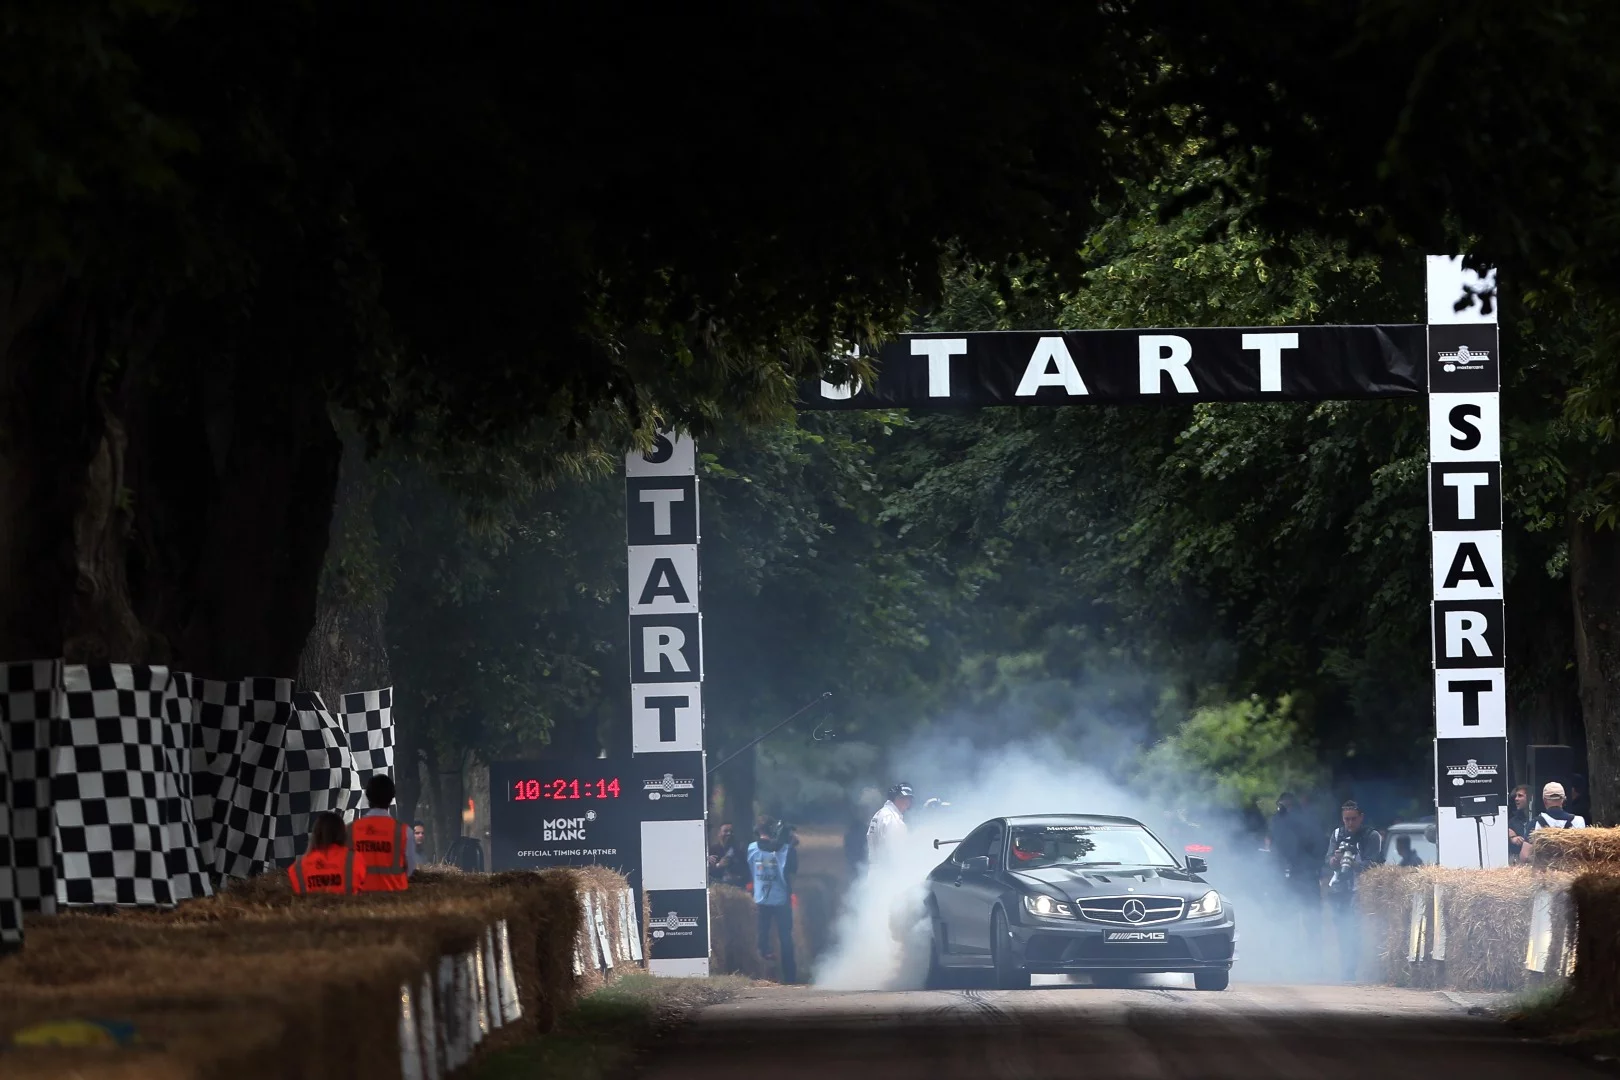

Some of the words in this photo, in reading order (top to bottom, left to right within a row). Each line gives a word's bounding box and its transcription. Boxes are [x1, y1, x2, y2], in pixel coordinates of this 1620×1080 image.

[1442, 403, 1495, 726] START
[515, 778, 620, 801] 10:21:14
[543, 817, 586, 830] MONT
[543, 829, 586, 841] BLANC
[356, 840, 392, 854] STEWARD
[582, 848, 617, 856] PARTNER
[1126, 932, 1165, 940] AMG
